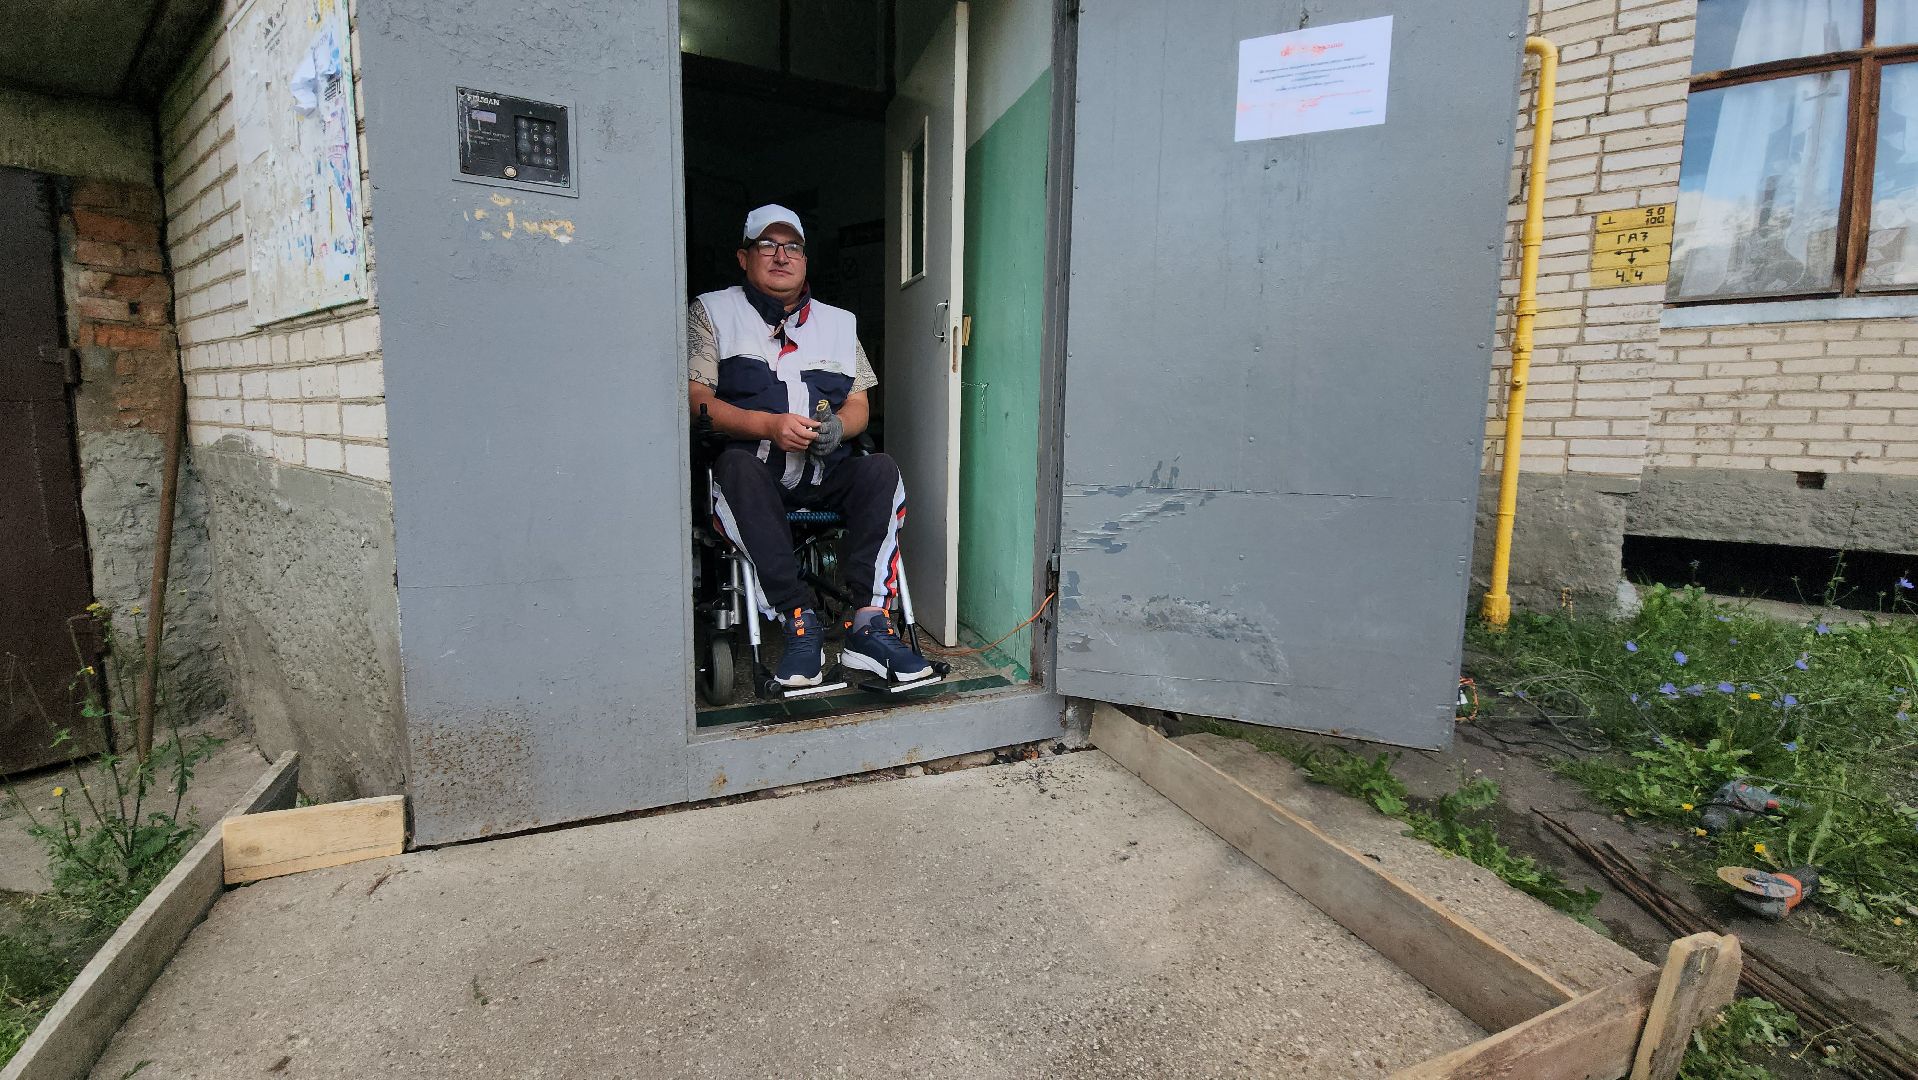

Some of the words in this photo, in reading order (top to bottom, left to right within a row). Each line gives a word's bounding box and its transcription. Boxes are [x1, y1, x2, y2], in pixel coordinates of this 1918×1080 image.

[532, 123, 539, 131] 2
[545, 125, 551, 133] 3
[533, 134, 539, 142] 5
[1645, 206, 1666, 217] 50
[1645, 215, 1665, 226] 100
[1617, 231, 1649, 245] ГАЗ
